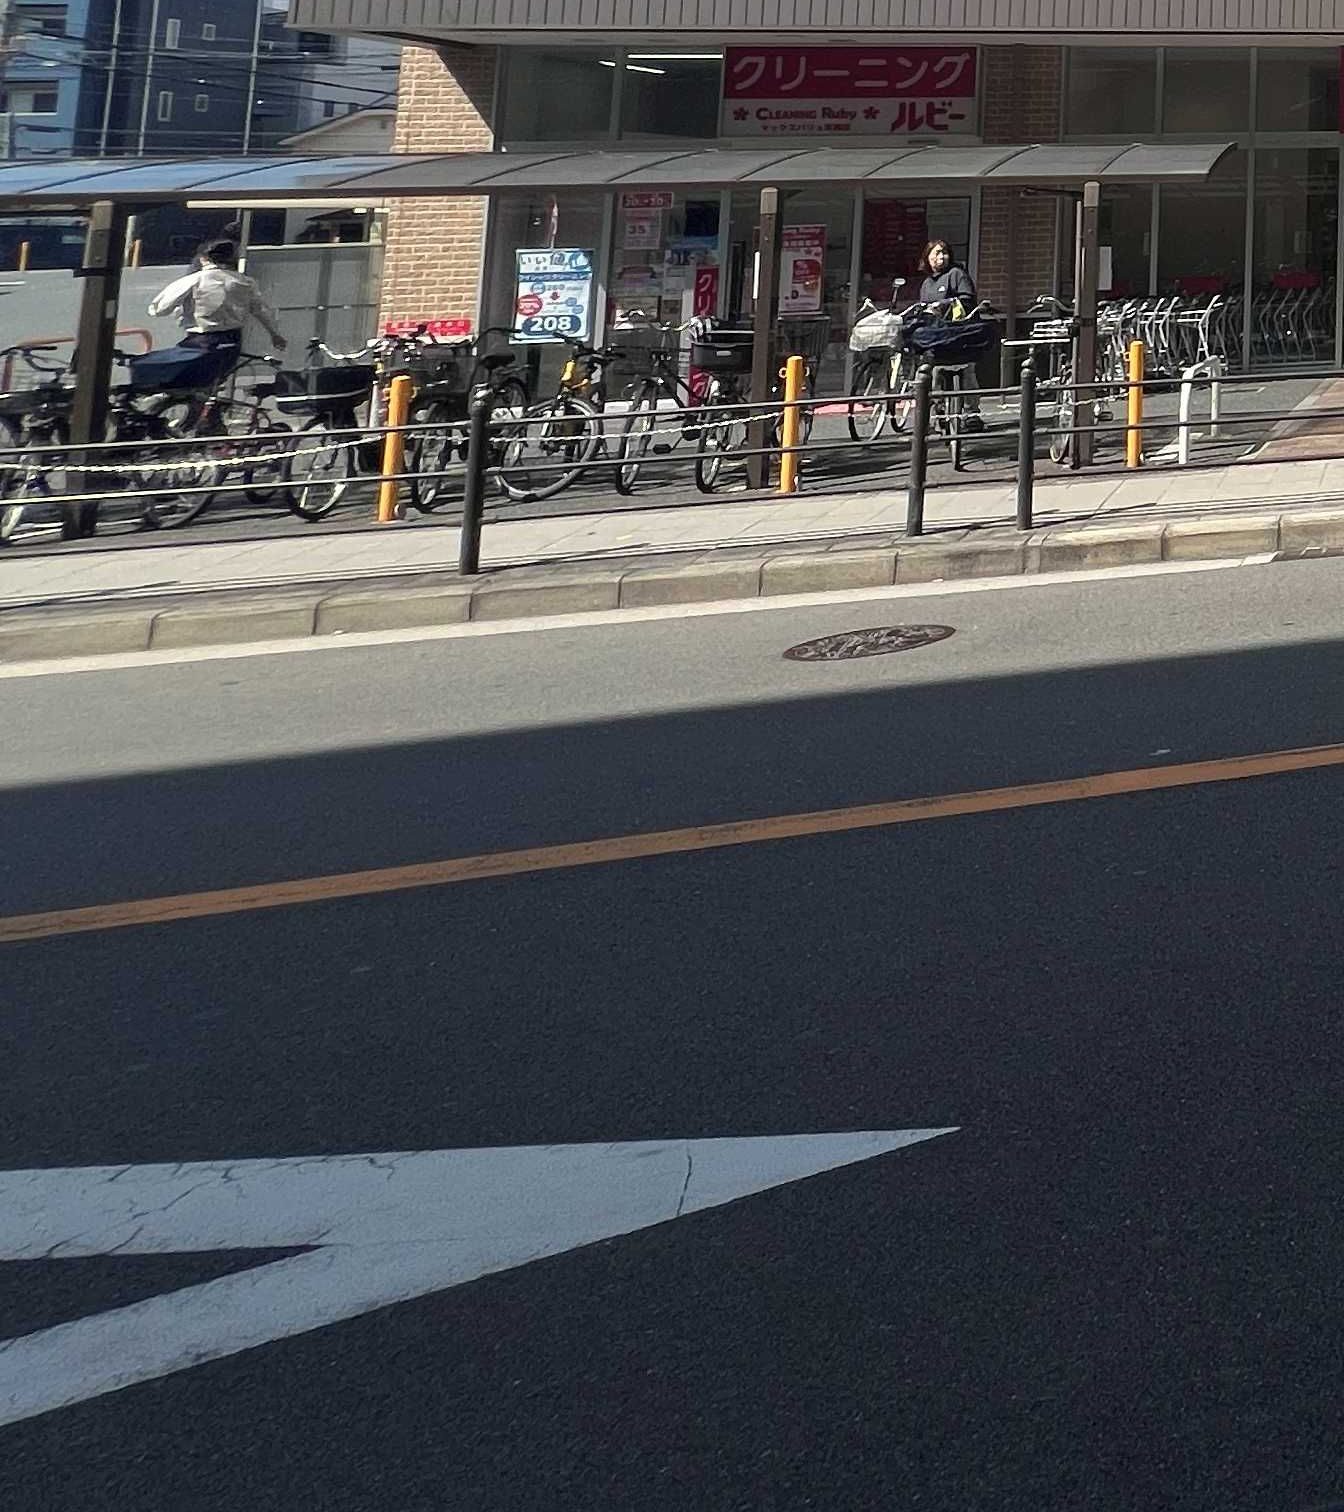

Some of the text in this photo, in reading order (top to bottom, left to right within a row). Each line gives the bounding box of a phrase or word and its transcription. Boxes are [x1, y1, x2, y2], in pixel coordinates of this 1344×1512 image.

[733, 53, 971, 91] クリーニング
[821, 105, 857, 122] Ruby
[890, 101, 967, 133] ルビー
[530, 316, 572, 332] 208
